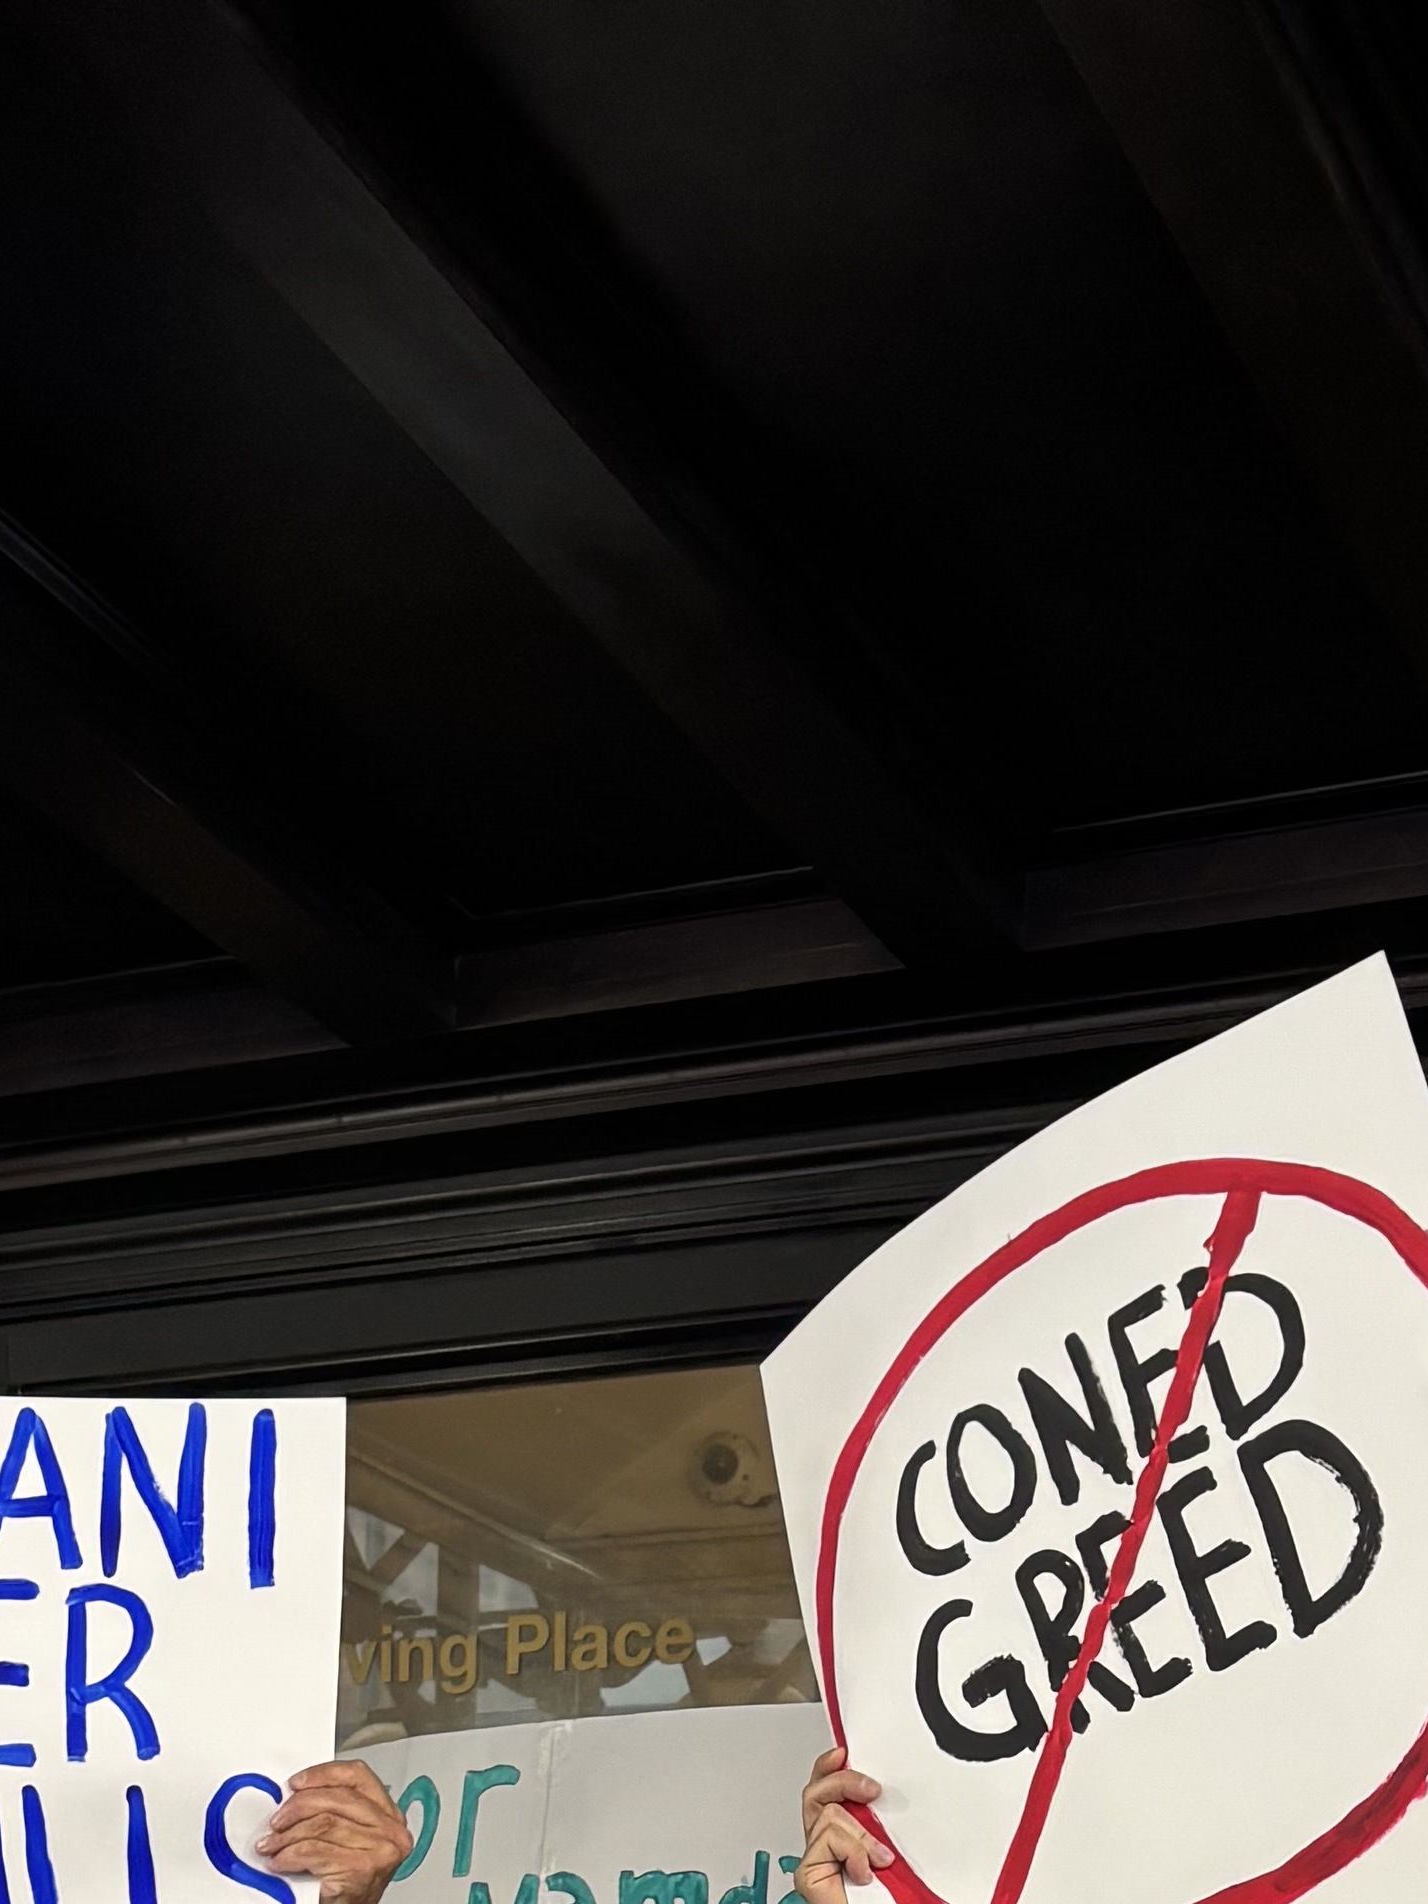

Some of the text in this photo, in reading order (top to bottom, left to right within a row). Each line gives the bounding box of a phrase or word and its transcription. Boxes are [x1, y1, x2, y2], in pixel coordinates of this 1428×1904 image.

[897, 1268, 1304, 1576] CONED
[342, 1610, 697, 1695] ving Place
[914, 1419, 1384, 1762] GREED
[386, 1764, 521, 1883] or
